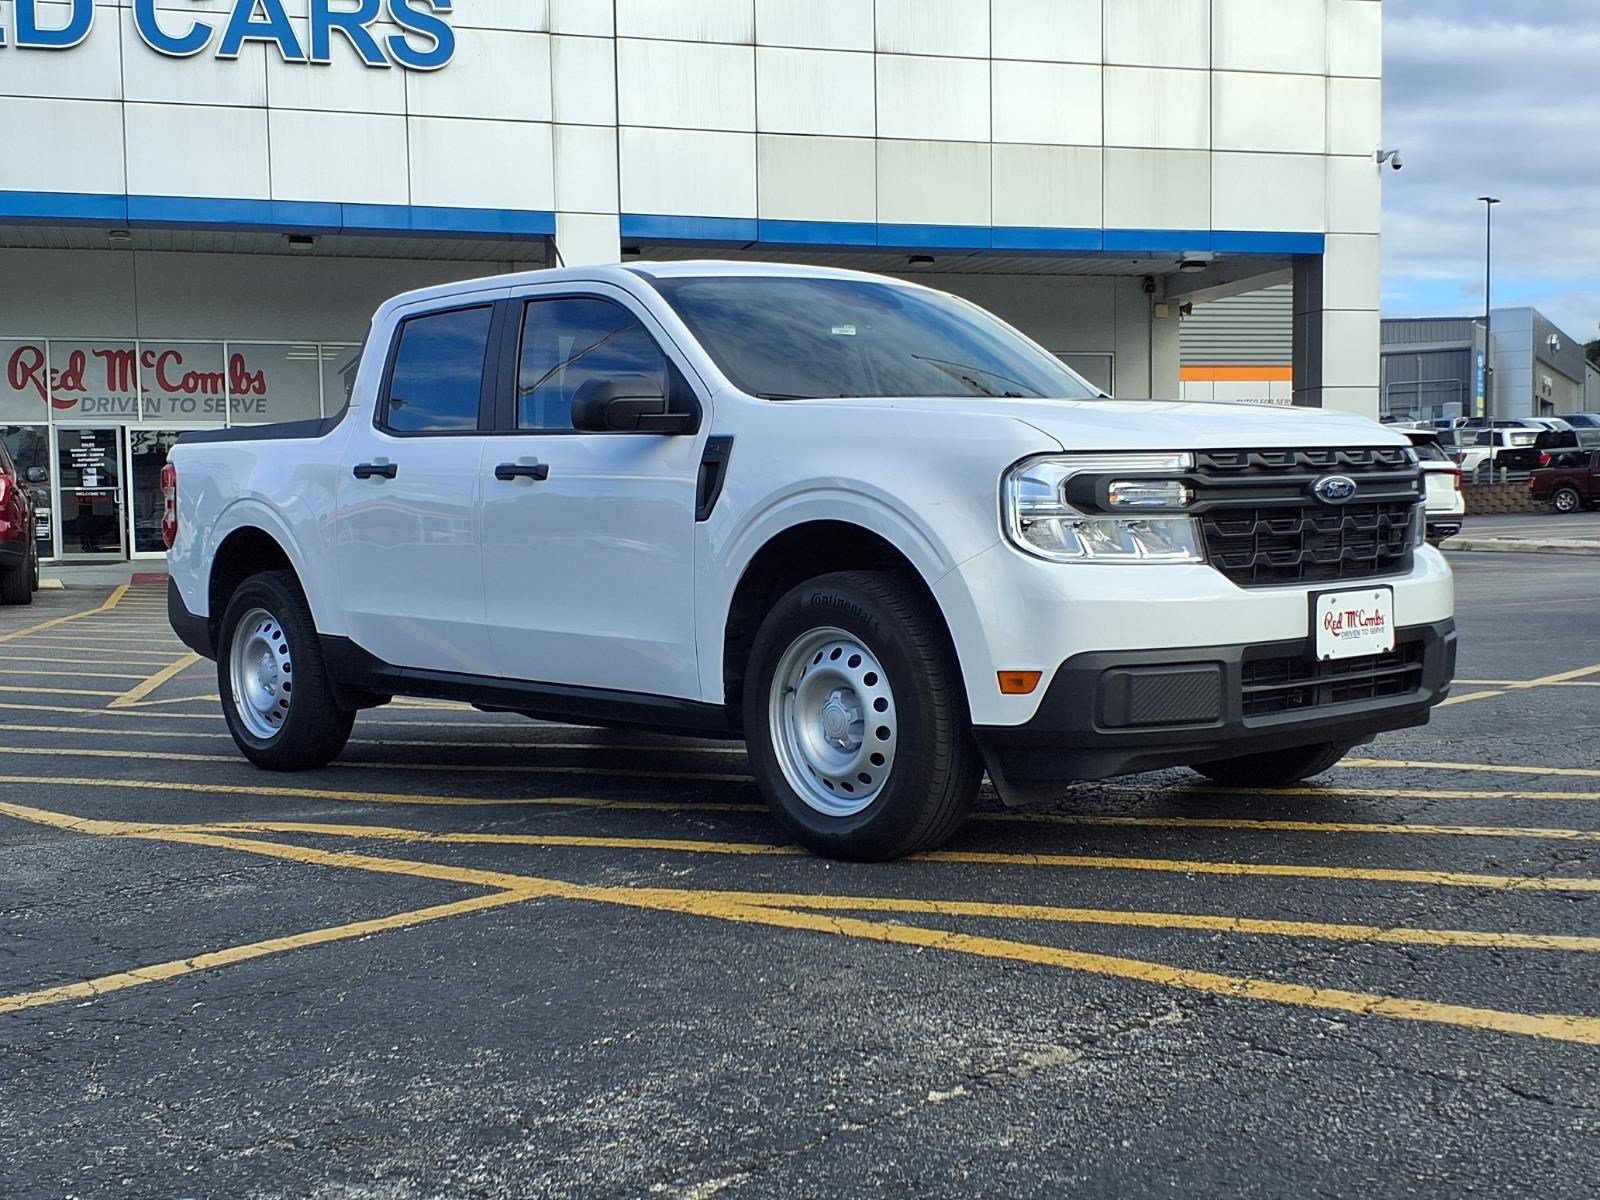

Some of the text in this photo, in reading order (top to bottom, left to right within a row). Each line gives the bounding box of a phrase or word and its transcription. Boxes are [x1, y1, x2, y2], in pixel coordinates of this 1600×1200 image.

[0, 0, 457, 71] D CARS
[8, 345, 267, 409] Red McCombs
[80, 397, 267, 414] DRIVEN TO SERVE
[810, 592, 874, 626] Continental
[1323, 608, 1385, 638] Red McCombs
